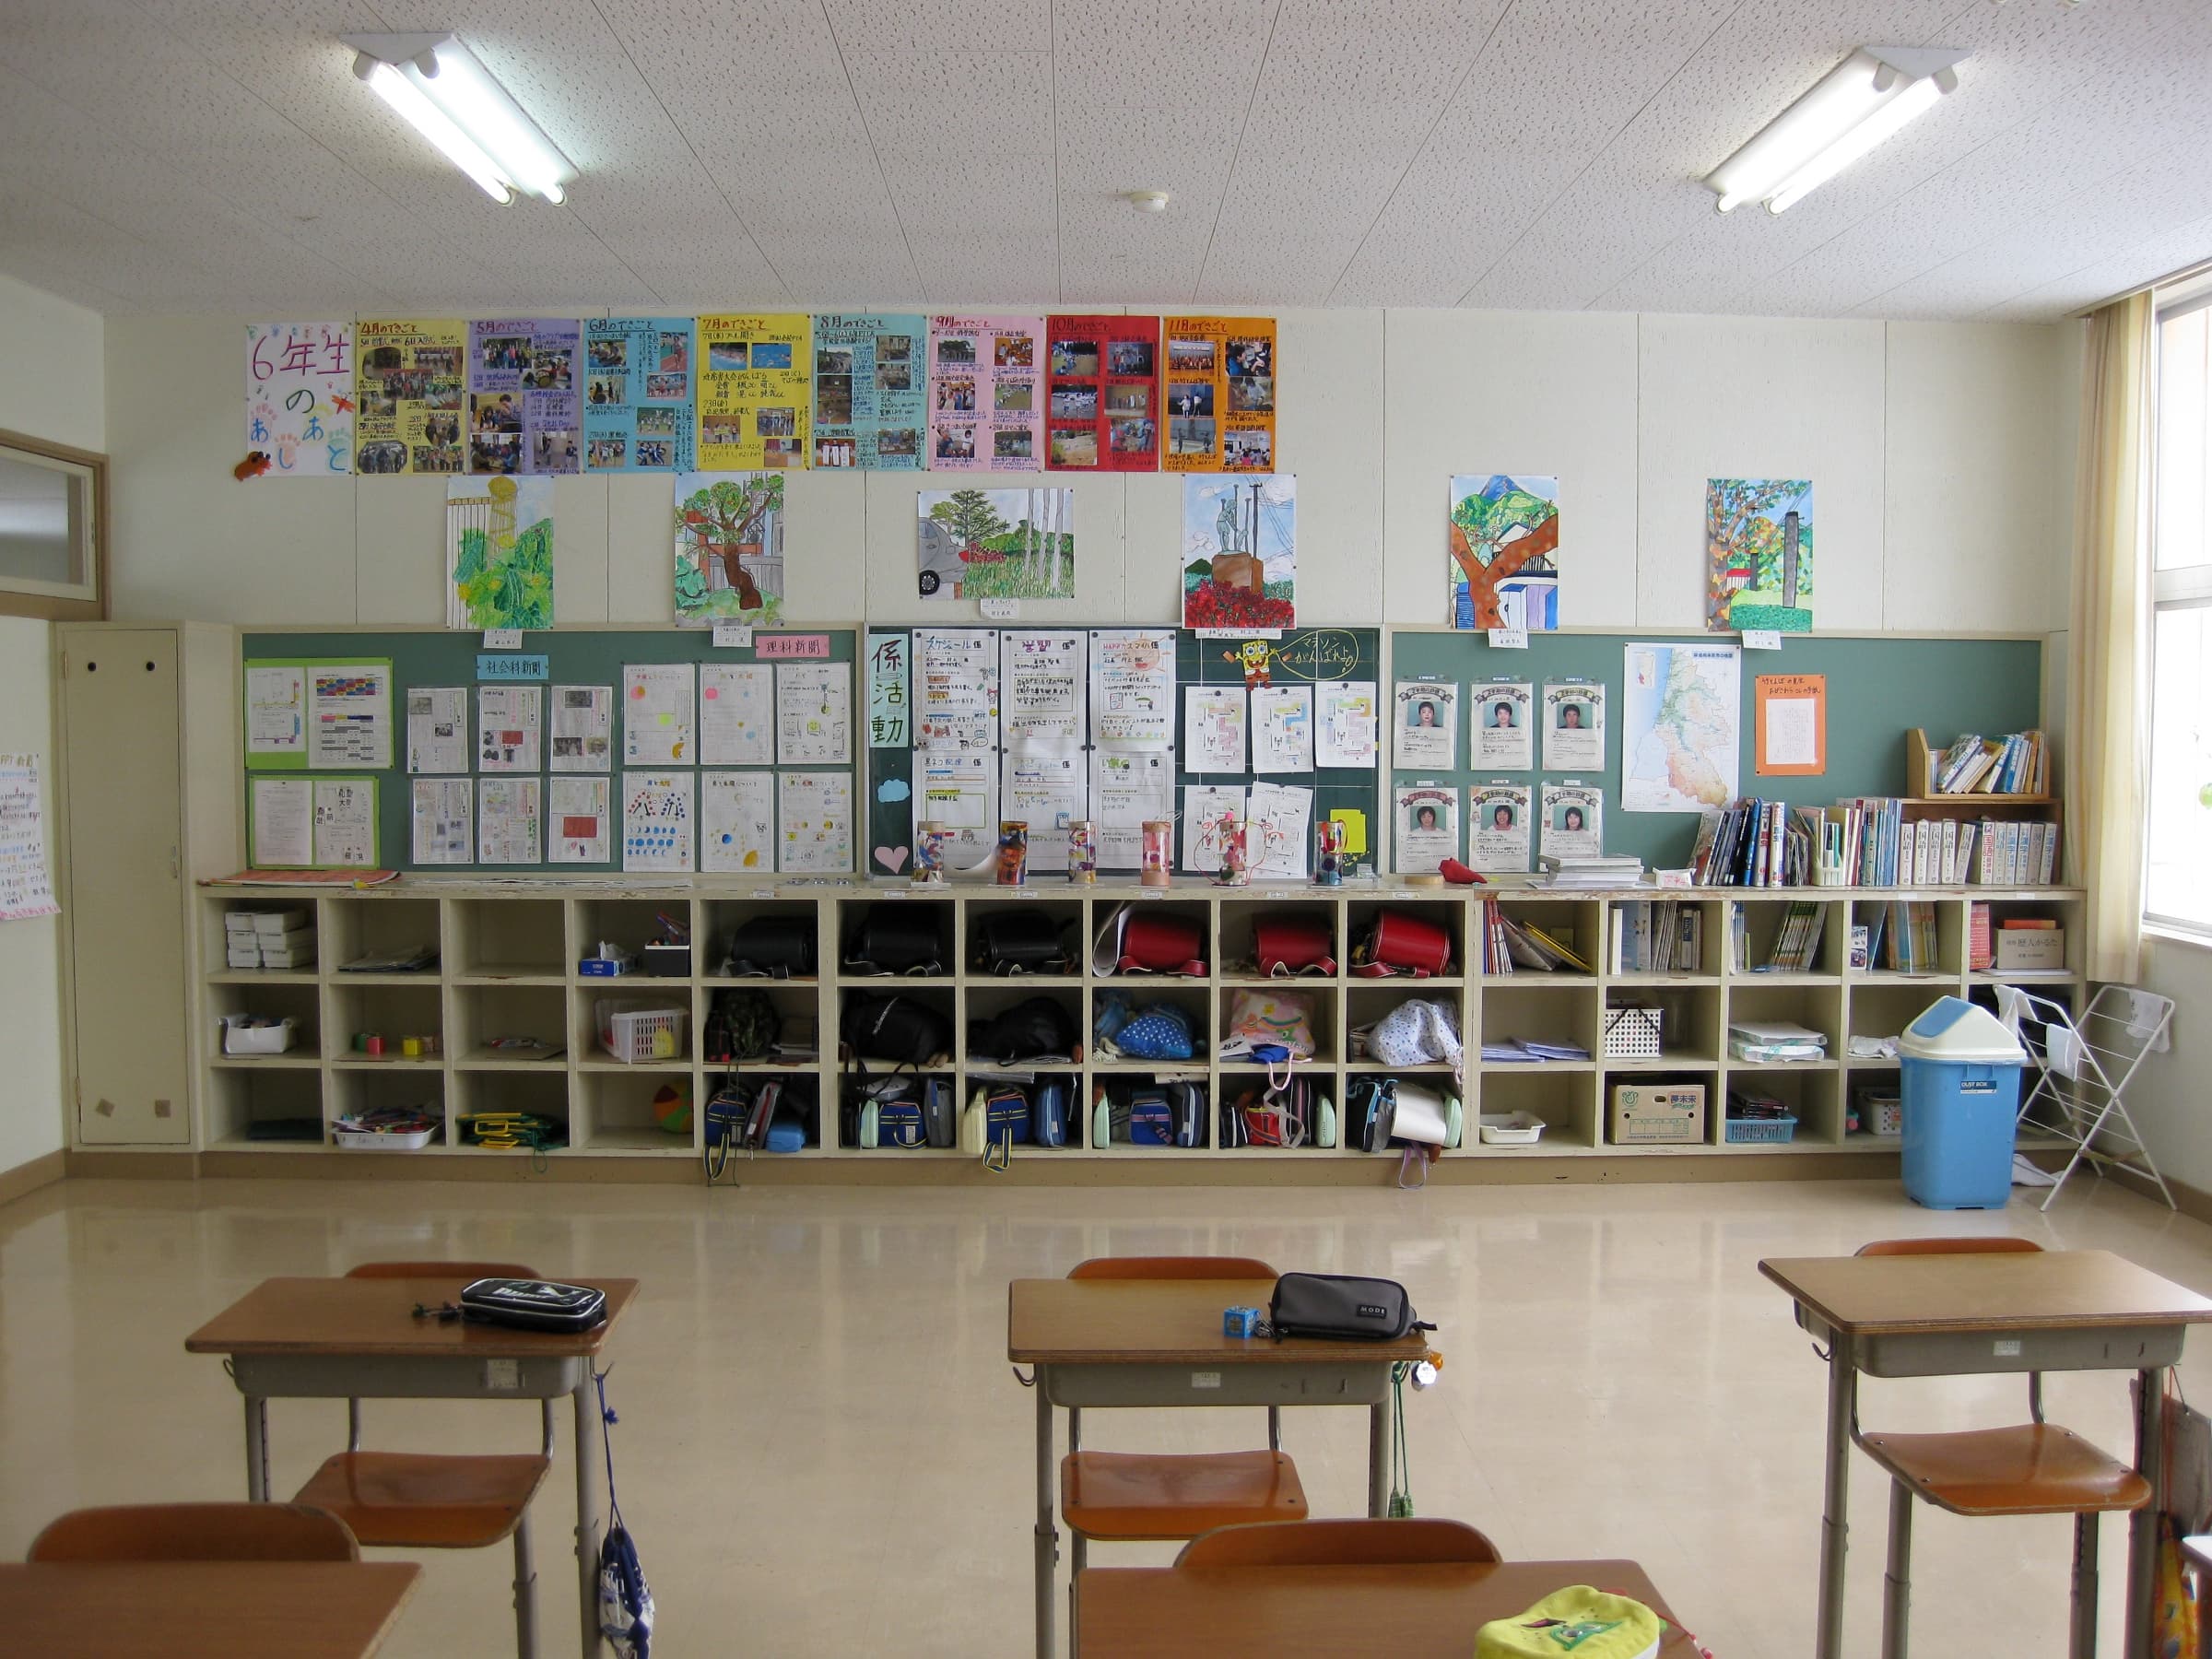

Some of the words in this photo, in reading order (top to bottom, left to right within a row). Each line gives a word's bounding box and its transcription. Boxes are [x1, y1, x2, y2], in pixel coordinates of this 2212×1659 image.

[476, 321, 537, 334] 5月のできごと
[589, 319, 655, 331] 6月のできごと
[702, 318, 767, 330] 7月のできごと
[820, 315, 885, 328] 8月のできごと
[935, 316, 990, 328] 9月のできごと
[1053, 318, 1111, 332] 10月のできごと
[1169, 320, 1228, 333] 11月のできごと
[360, 323, 418, 335] 4月のできごと
[253, 333, 350, 381] 6年生
[285, 388, 315, 415] の
[766, 639, 821, 656] 理科新聞
[926, 636, 971, 651] スケジュール
[1301, 635, 1340, 650] マラソン
[487, 660, 541, 676] 社会科新聞
[870, 638, 904, 744] 係活動
[1360, 1306, 1385, 1314] MODE
